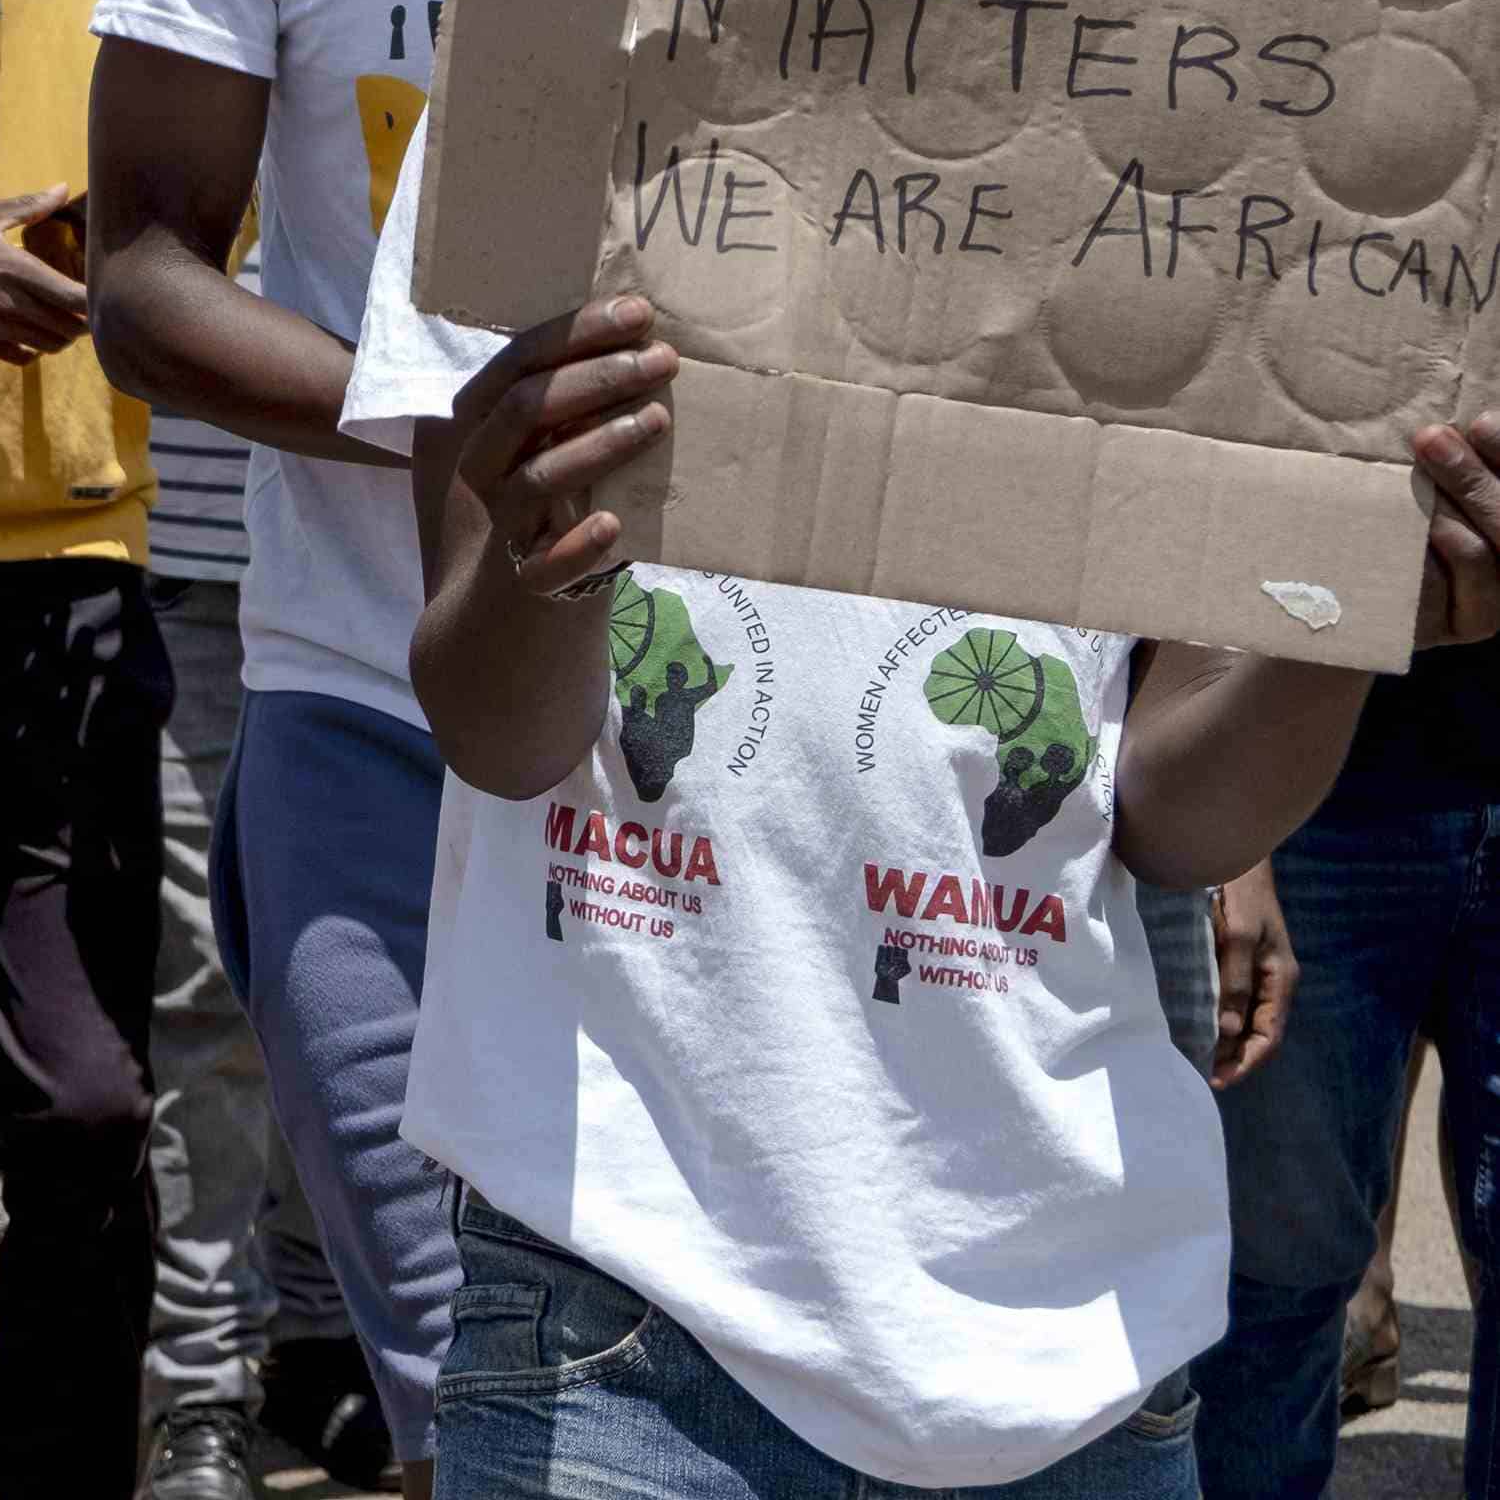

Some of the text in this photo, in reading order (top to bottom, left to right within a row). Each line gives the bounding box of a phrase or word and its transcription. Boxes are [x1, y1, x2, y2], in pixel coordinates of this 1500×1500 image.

[633, 120, 779, 254] WE
[828, 168, 1013, 255] ARE
[717, 574, 775, 778] UNITED IN ACTION
[855, 607, 975, 774] WOMEN AFFECTE
[544, 801, 722, 886] MACUA
[547, 860, 703, 915] NOTHING ABOUT US
[569, 898, 675, 939] WITHOUT US
[883, 926, 979, 958] NOTHING
[1015, 947, 1039, 967] US
[994, 974, 1009, 994] US
